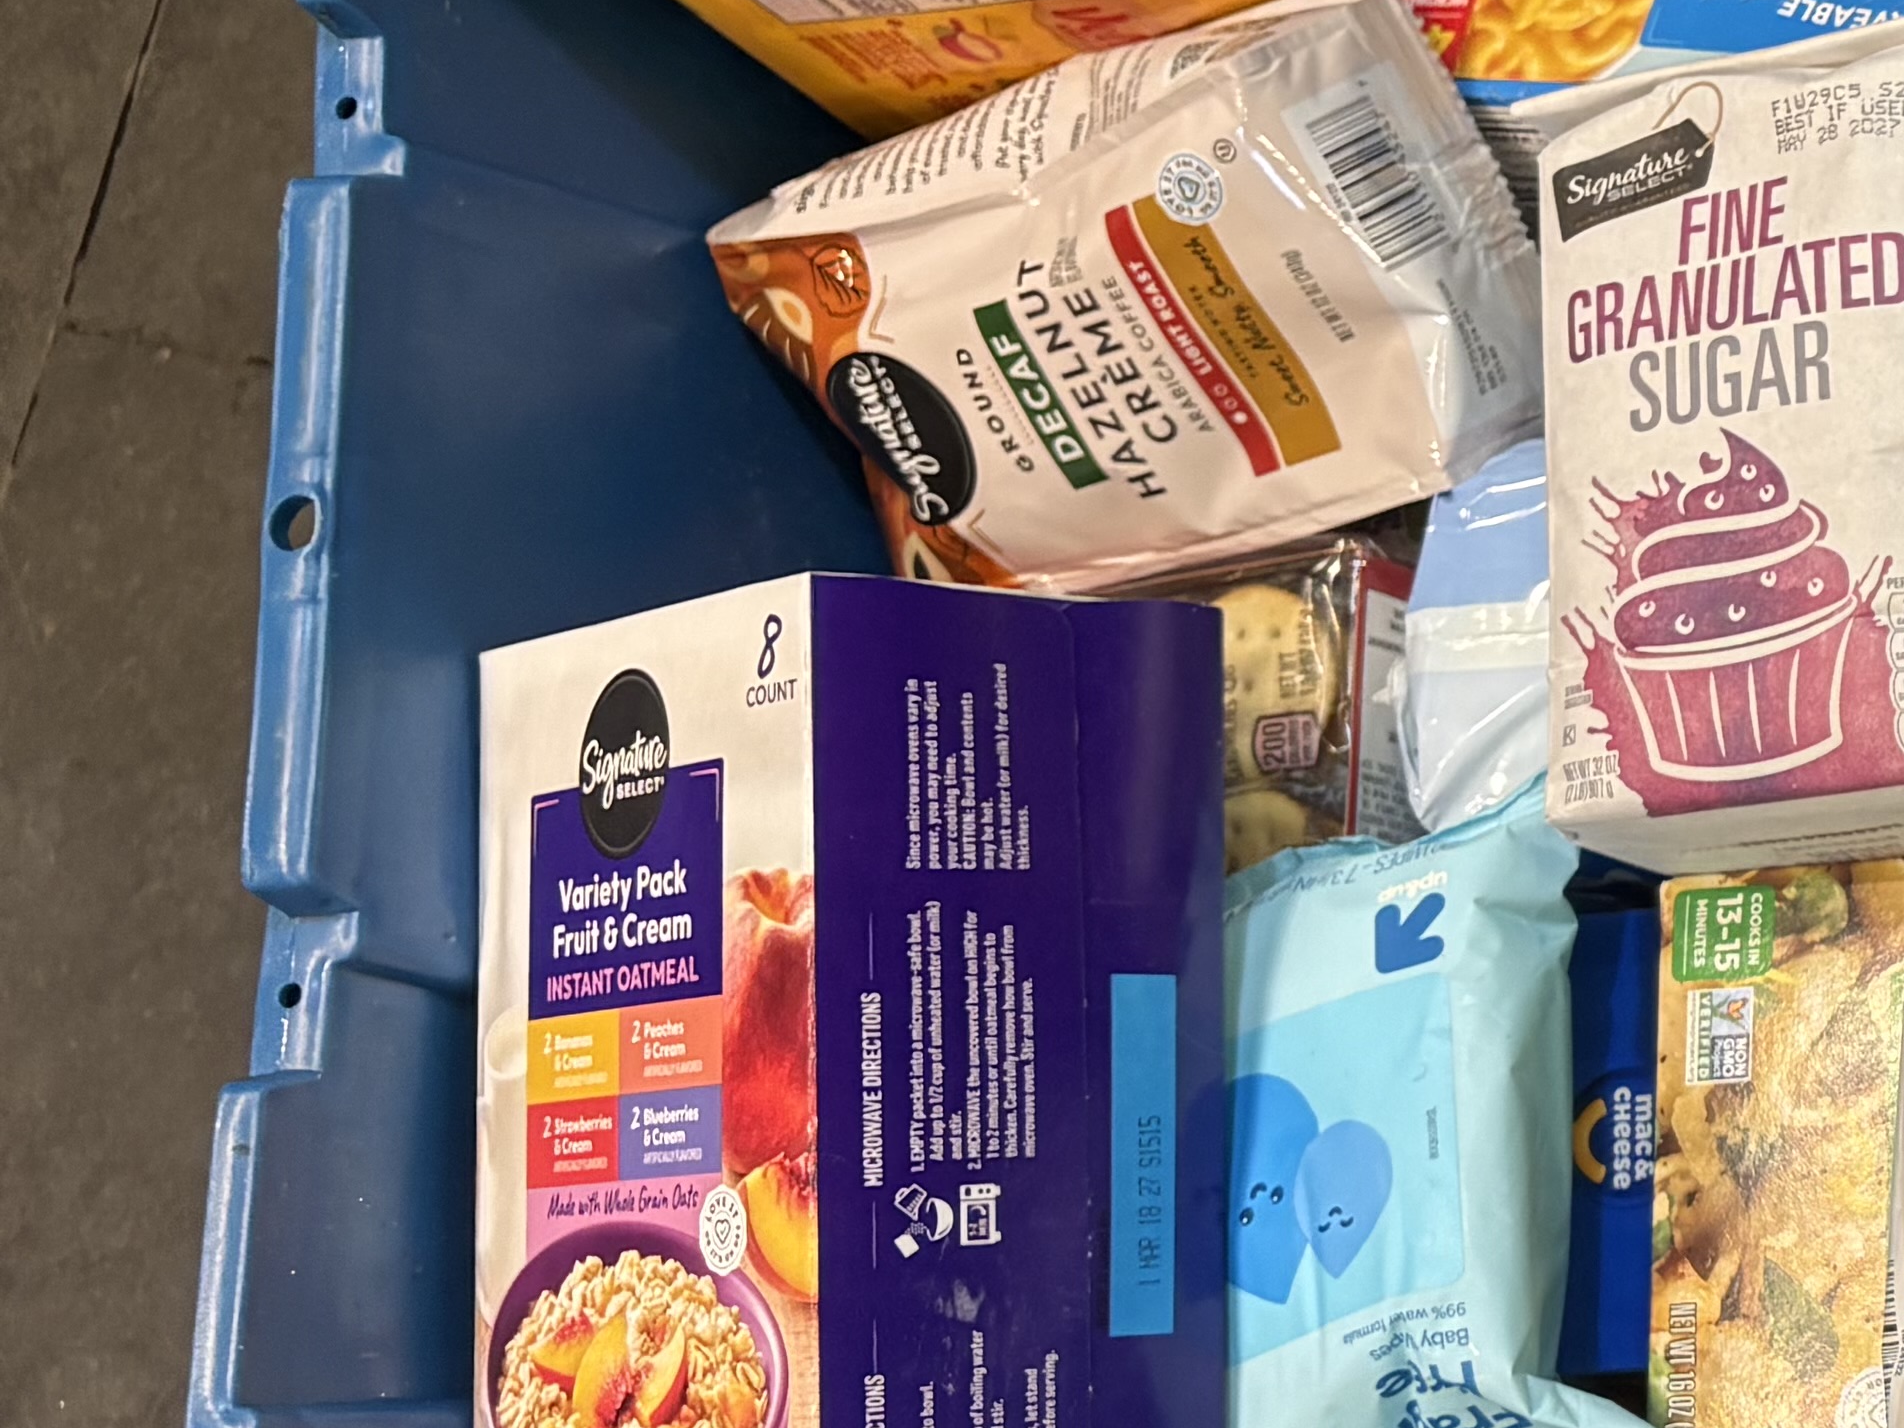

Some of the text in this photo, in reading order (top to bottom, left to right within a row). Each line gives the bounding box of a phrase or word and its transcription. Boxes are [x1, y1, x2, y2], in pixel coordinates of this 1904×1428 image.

[1566, 144, 1690, 207] Signature
[1606, 166, 1688, 203] SELECT
[1678, 175, 1790, 266] FINE
[1101, 275, 1216, 433] ARABICA COFFEE
[1126, 260, 1214, 376] LIGHT ROAST
[956, 348, 1035, 473] GROUND
[989, 334, 1084, 463] DECAF
[1016, 260, 1168, 499] HAZELNUT
[1629, 320, 1832, 433] SUGAR
[848, 358, 949, 521] Signature
[757, 614, 783, 679] 8
[746, 678, 798, 708] COUNT
[582, 729, 668, 810] Signature
[616, 776, 665, 801] SELECT
[558, 859, 688, 913] Variety Pack
[552, 913, 692, 959] Fruit & Cream
[1694, 899, 1708, 969] MINUTES
[1714, 894, 1744, 972] 13-15
[1747, 892, 1763, 966] COOKS IN
[547, 956, 700, 1003] INSTANT OATMEAL
[631, 1019, 684, 1044] 2 Peaches
[1699, 994, 1712, 1080] VERIFIED
[860, 991, 885, 1188] MICROWAVE DIRECTIONS
[1635, 1094, 1653, 1151] mac
[1613, 1085, 1631, 1190] cheese
[1420, 1328, 1470, 1350] Baby
